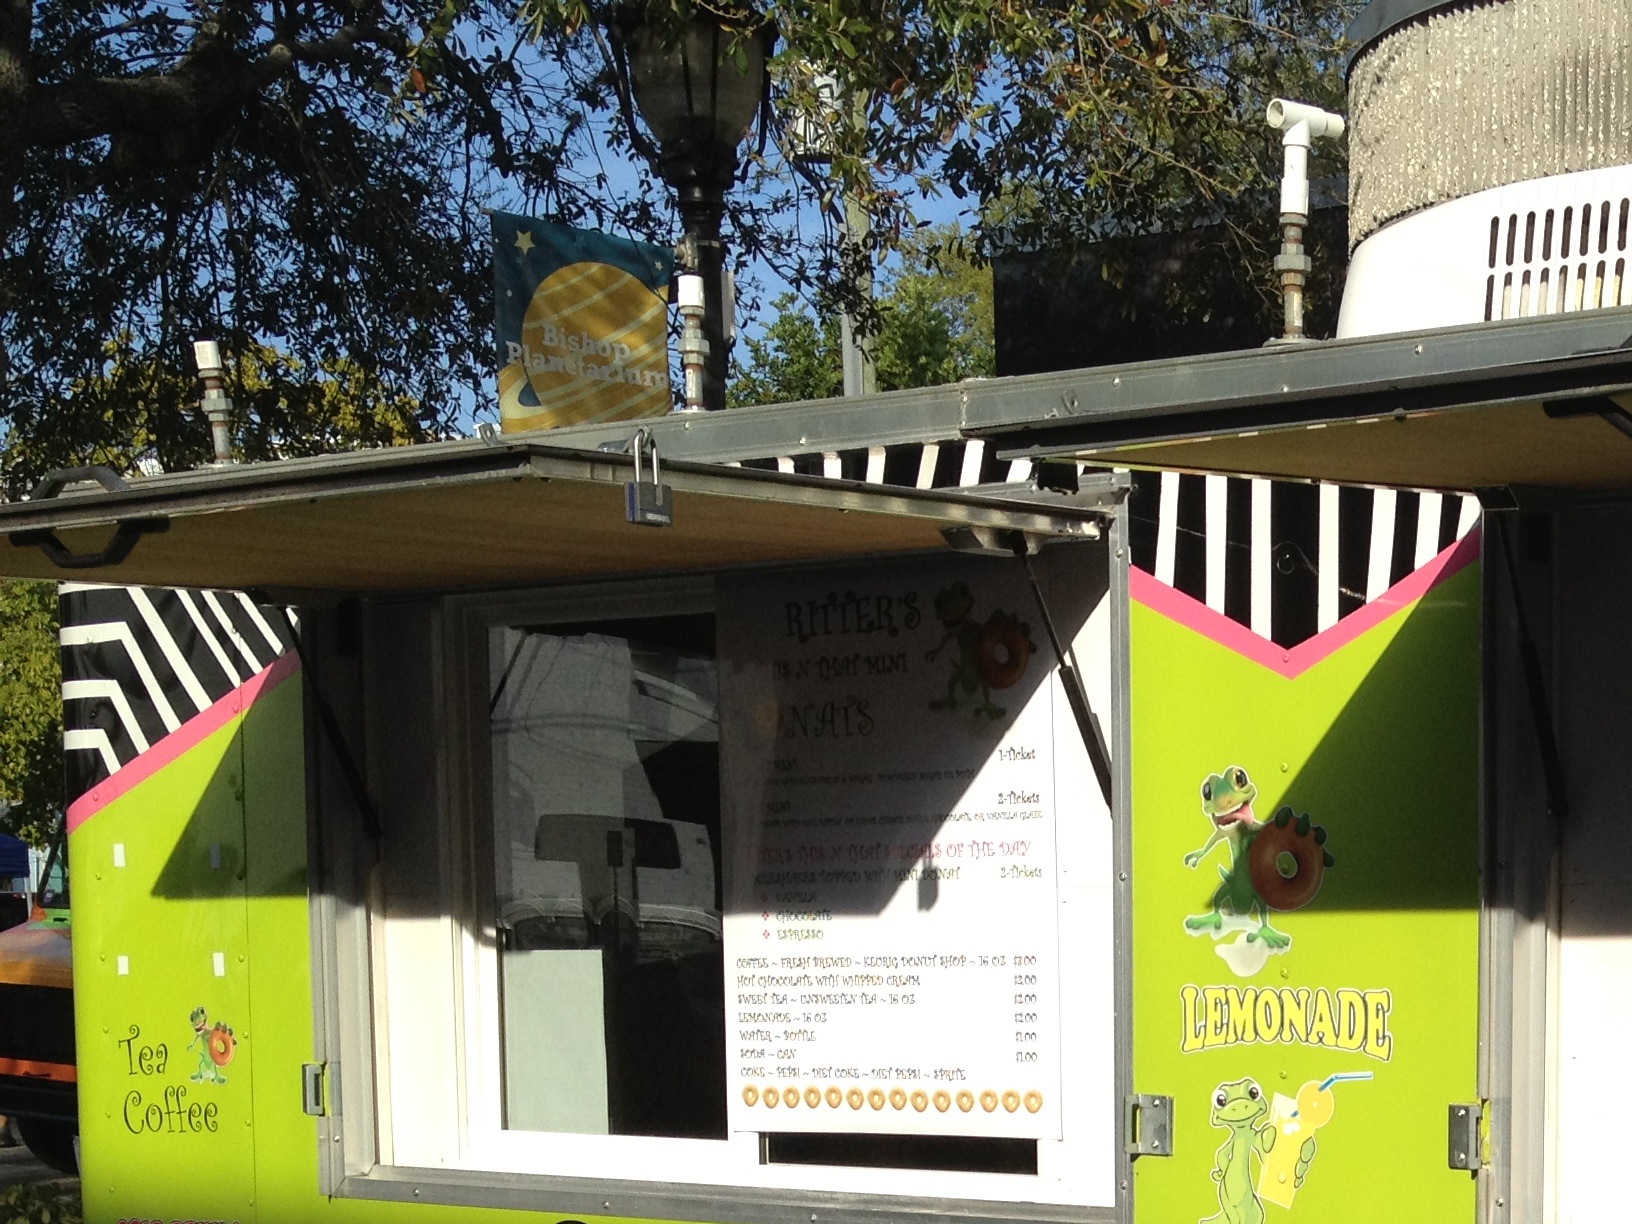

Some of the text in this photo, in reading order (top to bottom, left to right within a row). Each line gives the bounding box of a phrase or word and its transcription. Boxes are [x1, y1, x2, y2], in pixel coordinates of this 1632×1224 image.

[542, 323, 630, 366] Bishop
[785, 590, 922, 643] RITTER'S
[998, 790, 1040, 804] 2-Tickets
[946, 843, 964, 858] OF
[968, 840, 996, 860] THE
[999, 840, 1032, 857] DAY
[1001, 864, 1043, 879] 2-Tickets
[777, 928, 824, 941] ESPRESSO
[736, 957, 769, 969] COFFEE
[781, 956, 811, 969] FRESH
[812, 956, 852, 969] BREWED
[940, 955, 967, 969] SHOP
[737, 974, 756, 988] HOT
[757, 974, 813, 989] CHOCOLATE
[815, 974, 839, 988] WITH
[842, 974, 884, 988] WHIPPED
[886, 974, 921, 988] CREAM
[737, 992, 768, 1005] SWEET
[771, 993, 788, 1005] TEA
[859, 992, 877, 1005] TEA
[738, 1012, 792, 1024] LEMONADE
[1180, 984, 1393, 1062] LEMONADE
[739, 1029, 772, 1043] WATER
[783, 1029, 817, 1042] BOTTLE
[118, 1024, 169, 1076] Tea
[740, 1048, 766, 1060] SODA
[776, 1048, 798, 1060] CAN
[740, 1066, 766, 1078] COKE
[776, 1066, 801, 1078] PEPSI
[812, 1066, 833, 1079] DIET
[834, 1067, 860, 1079] COKE
[871, 1067, 893, 1079] DIET
[895, 1067, 921, 1080] PEPSI
[933, 1067, 966, 1082] SPRITE
[122, 1085, 219, 1135] Coffee
